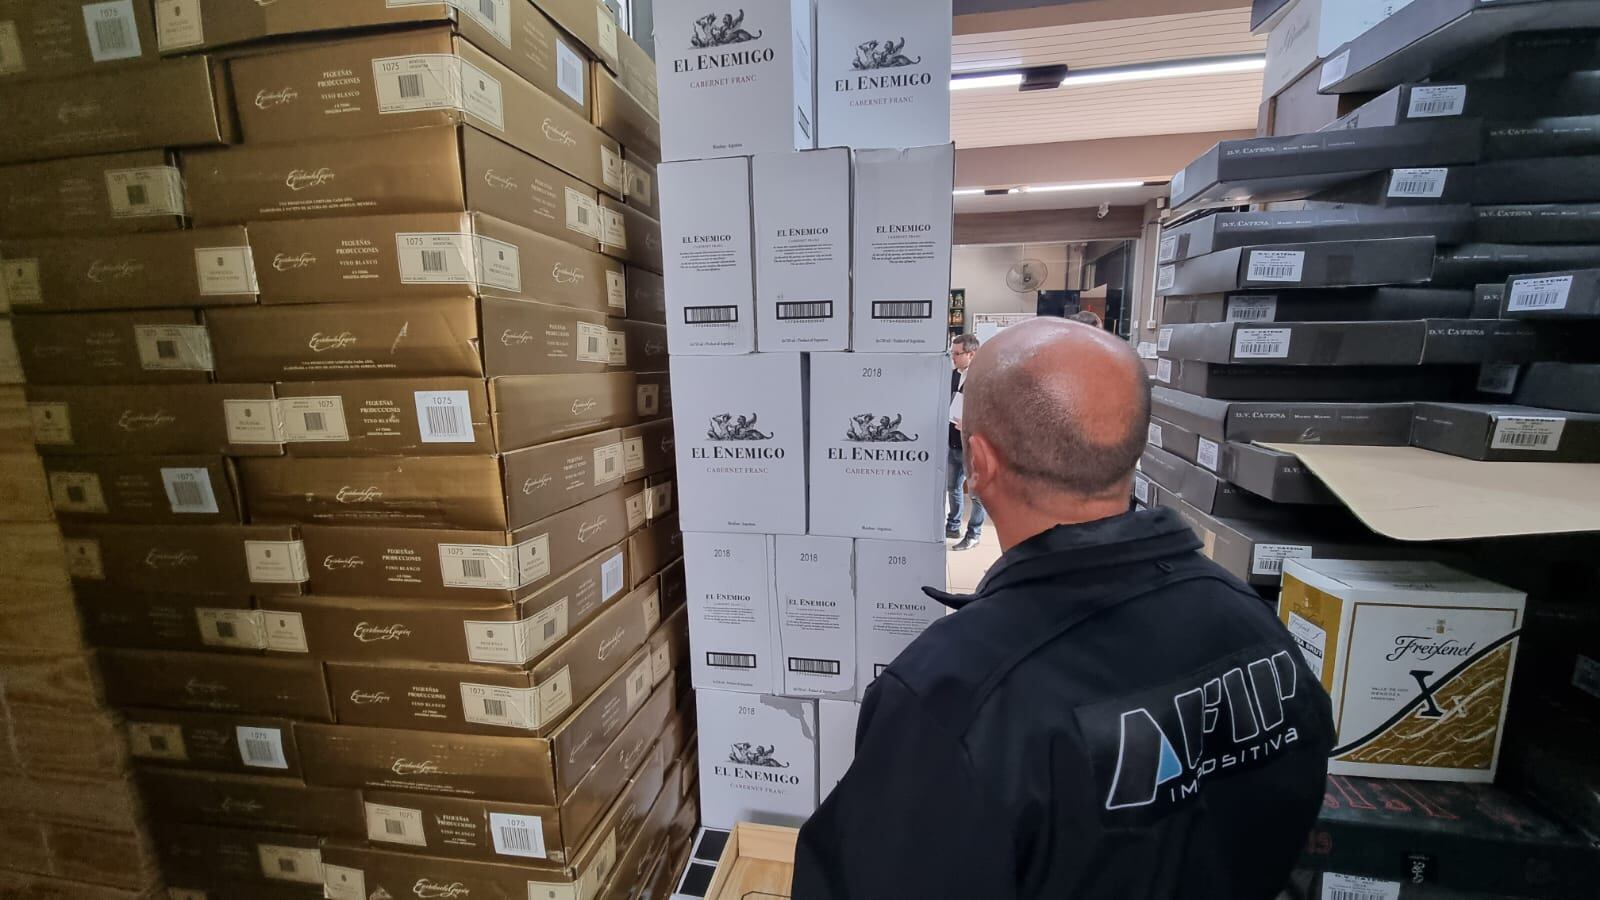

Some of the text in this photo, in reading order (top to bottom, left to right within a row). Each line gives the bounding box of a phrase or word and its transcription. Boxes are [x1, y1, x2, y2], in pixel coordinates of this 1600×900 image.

[100, 8, 118, 17] 1075
[674, 48, 774, 73] EL ENEMIGO
[382, 62, 400, 72] 1075
[690, 74, 757, 89] CABERNET FRANC
[834, 72, 932, 92] EL ENEMIGO
[850, 96, 913, 107] CABERNET FRANC
[1508, 128, 1544, 136] CATENA
[1243, 146, 1276, 154] CATENA
[789, 228, 828, 236] ENEMIGO
[889, 224, 931, 233] ENEMIGO
[406, 238, 423, 246] 1075
[682, 234, 732, 244] EL ENEMIGO
[1428, 328, 1484, 336] D.V. CATENA
[862, 368, 882, 378] 2018
[318, 400, 334, 408] 1075
[433, 396, 452, 405] 1075
[692, 446, 784, 459] EL ENEMIGO
[828, 447, 929, 462] EL ENEMIGO
[846, 468, 884, 476] CABERNET
[448, 548, 464, 556] 1075
[714, 549, 730, 558] 2018
[800, 553, 818, 562] 2018
[888, 556, 906, 565] 2018
[800, 599, 836, 607] ENEMIGO
[888, 602, 926, 611] ENEMIGO
[1386, 636, 1477, 661] Freixenet
[738, 706, 755, 716] 2018
[252, 732, 267, 740] 1075
[714, 766, 800, 785] EL ENEMIGO
[730, 782, 784, 795] CABERNET FRANC
[506, 818, 526, 826] 1075
